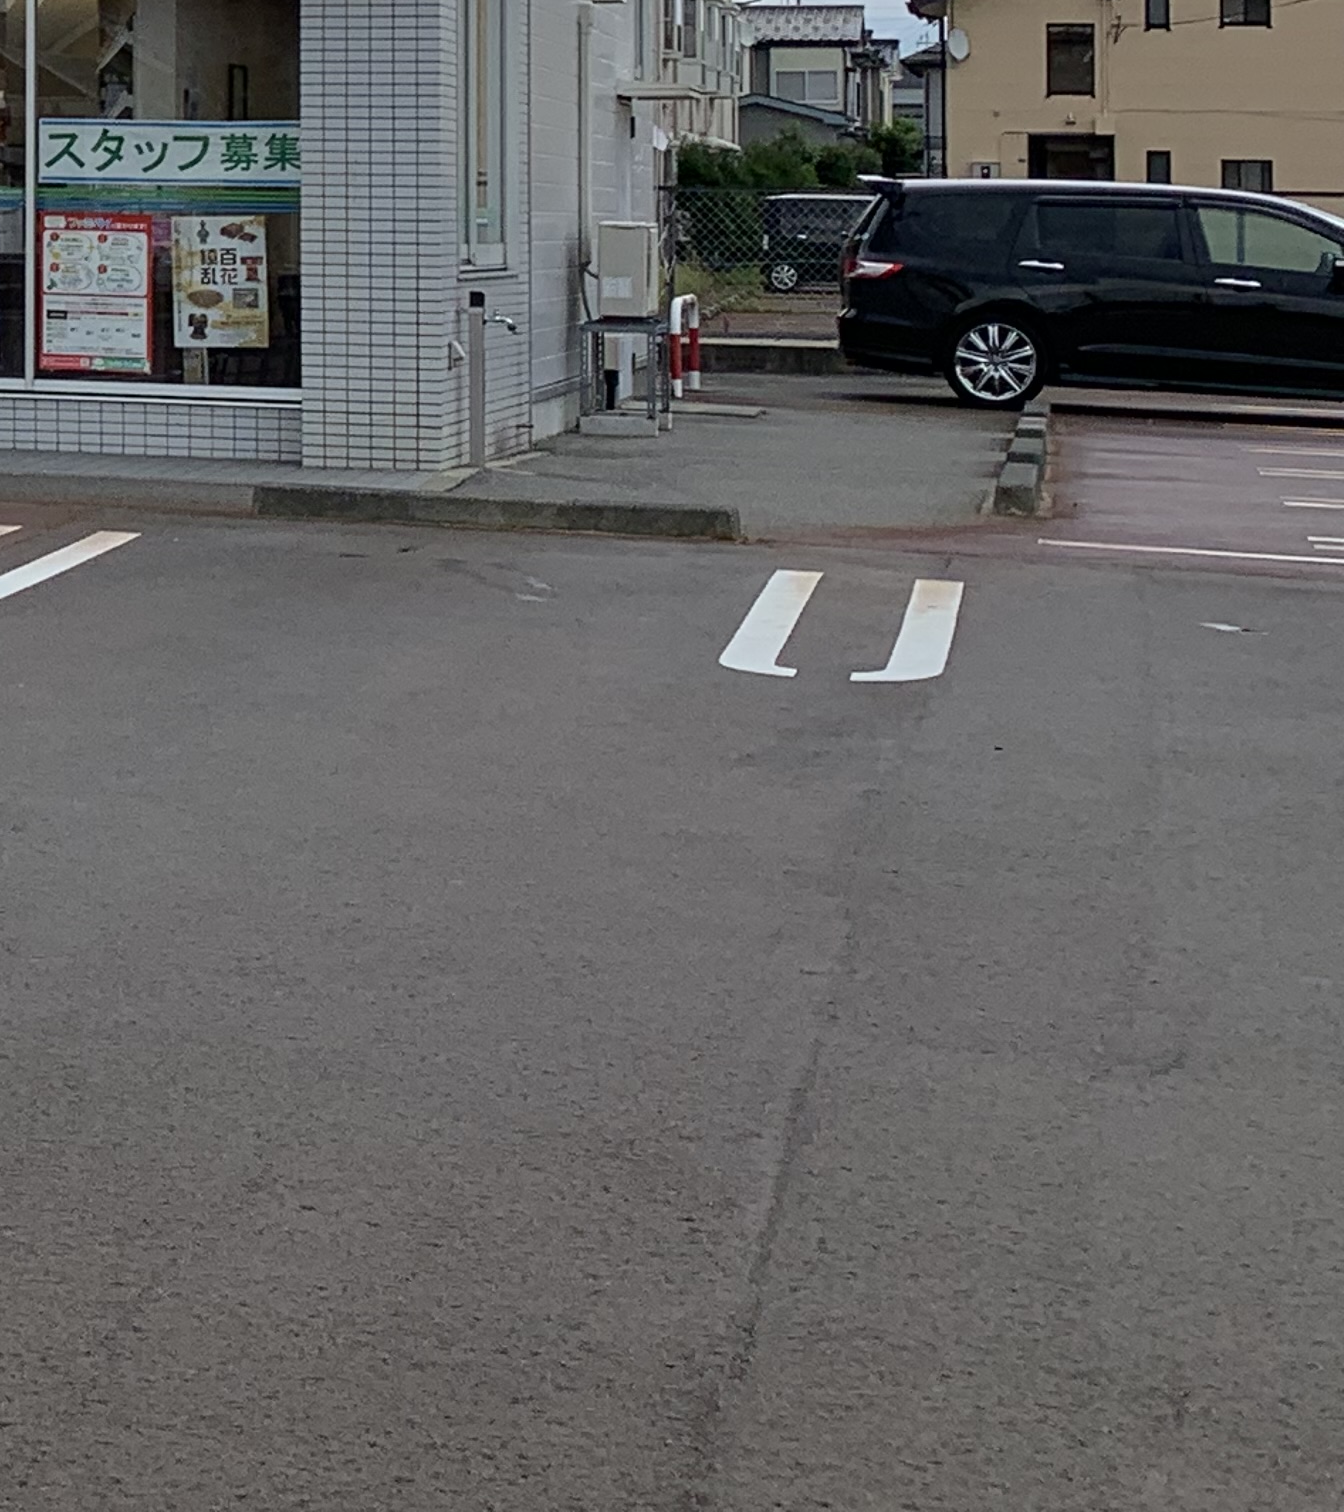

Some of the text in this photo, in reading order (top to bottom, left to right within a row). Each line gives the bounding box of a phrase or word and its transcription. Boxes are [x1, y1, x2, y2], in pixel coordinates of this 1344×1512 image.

[44, 128, 301, 173] スタッフ募集
[220, 247, 238, 286] 百花
